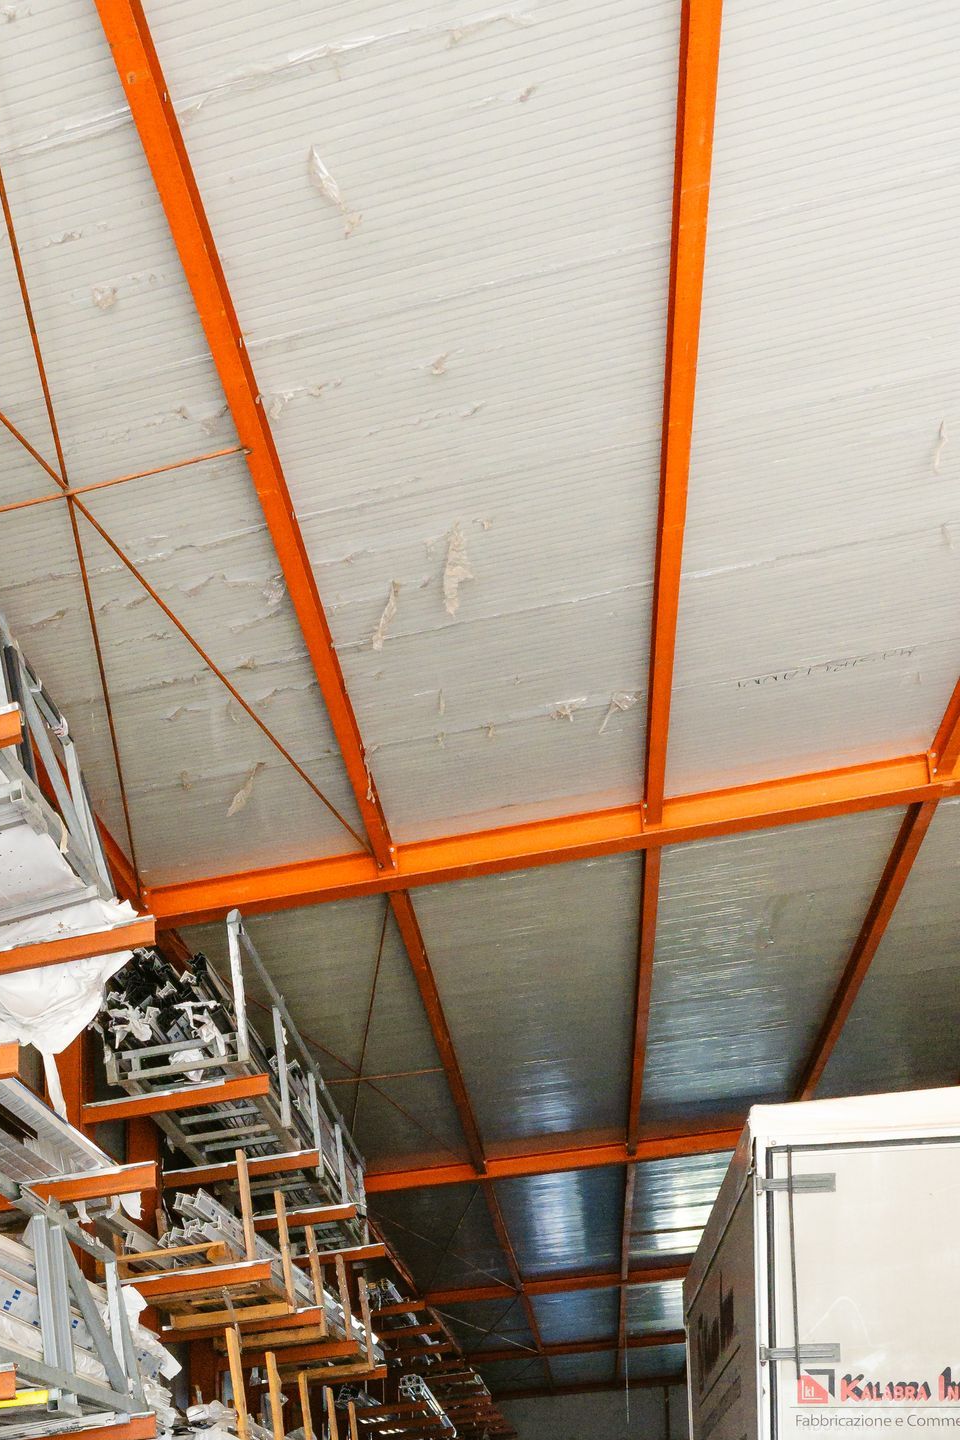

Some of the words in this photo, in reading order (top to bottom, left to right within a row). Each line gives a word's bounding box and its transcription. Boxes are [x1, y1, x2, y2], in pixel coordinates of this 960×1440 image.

[841, 1373, 932, 1403] KALABRA
[795, 1414, 891, 1428] Fabbricazione
[895, 1417, 904, 1427] e
